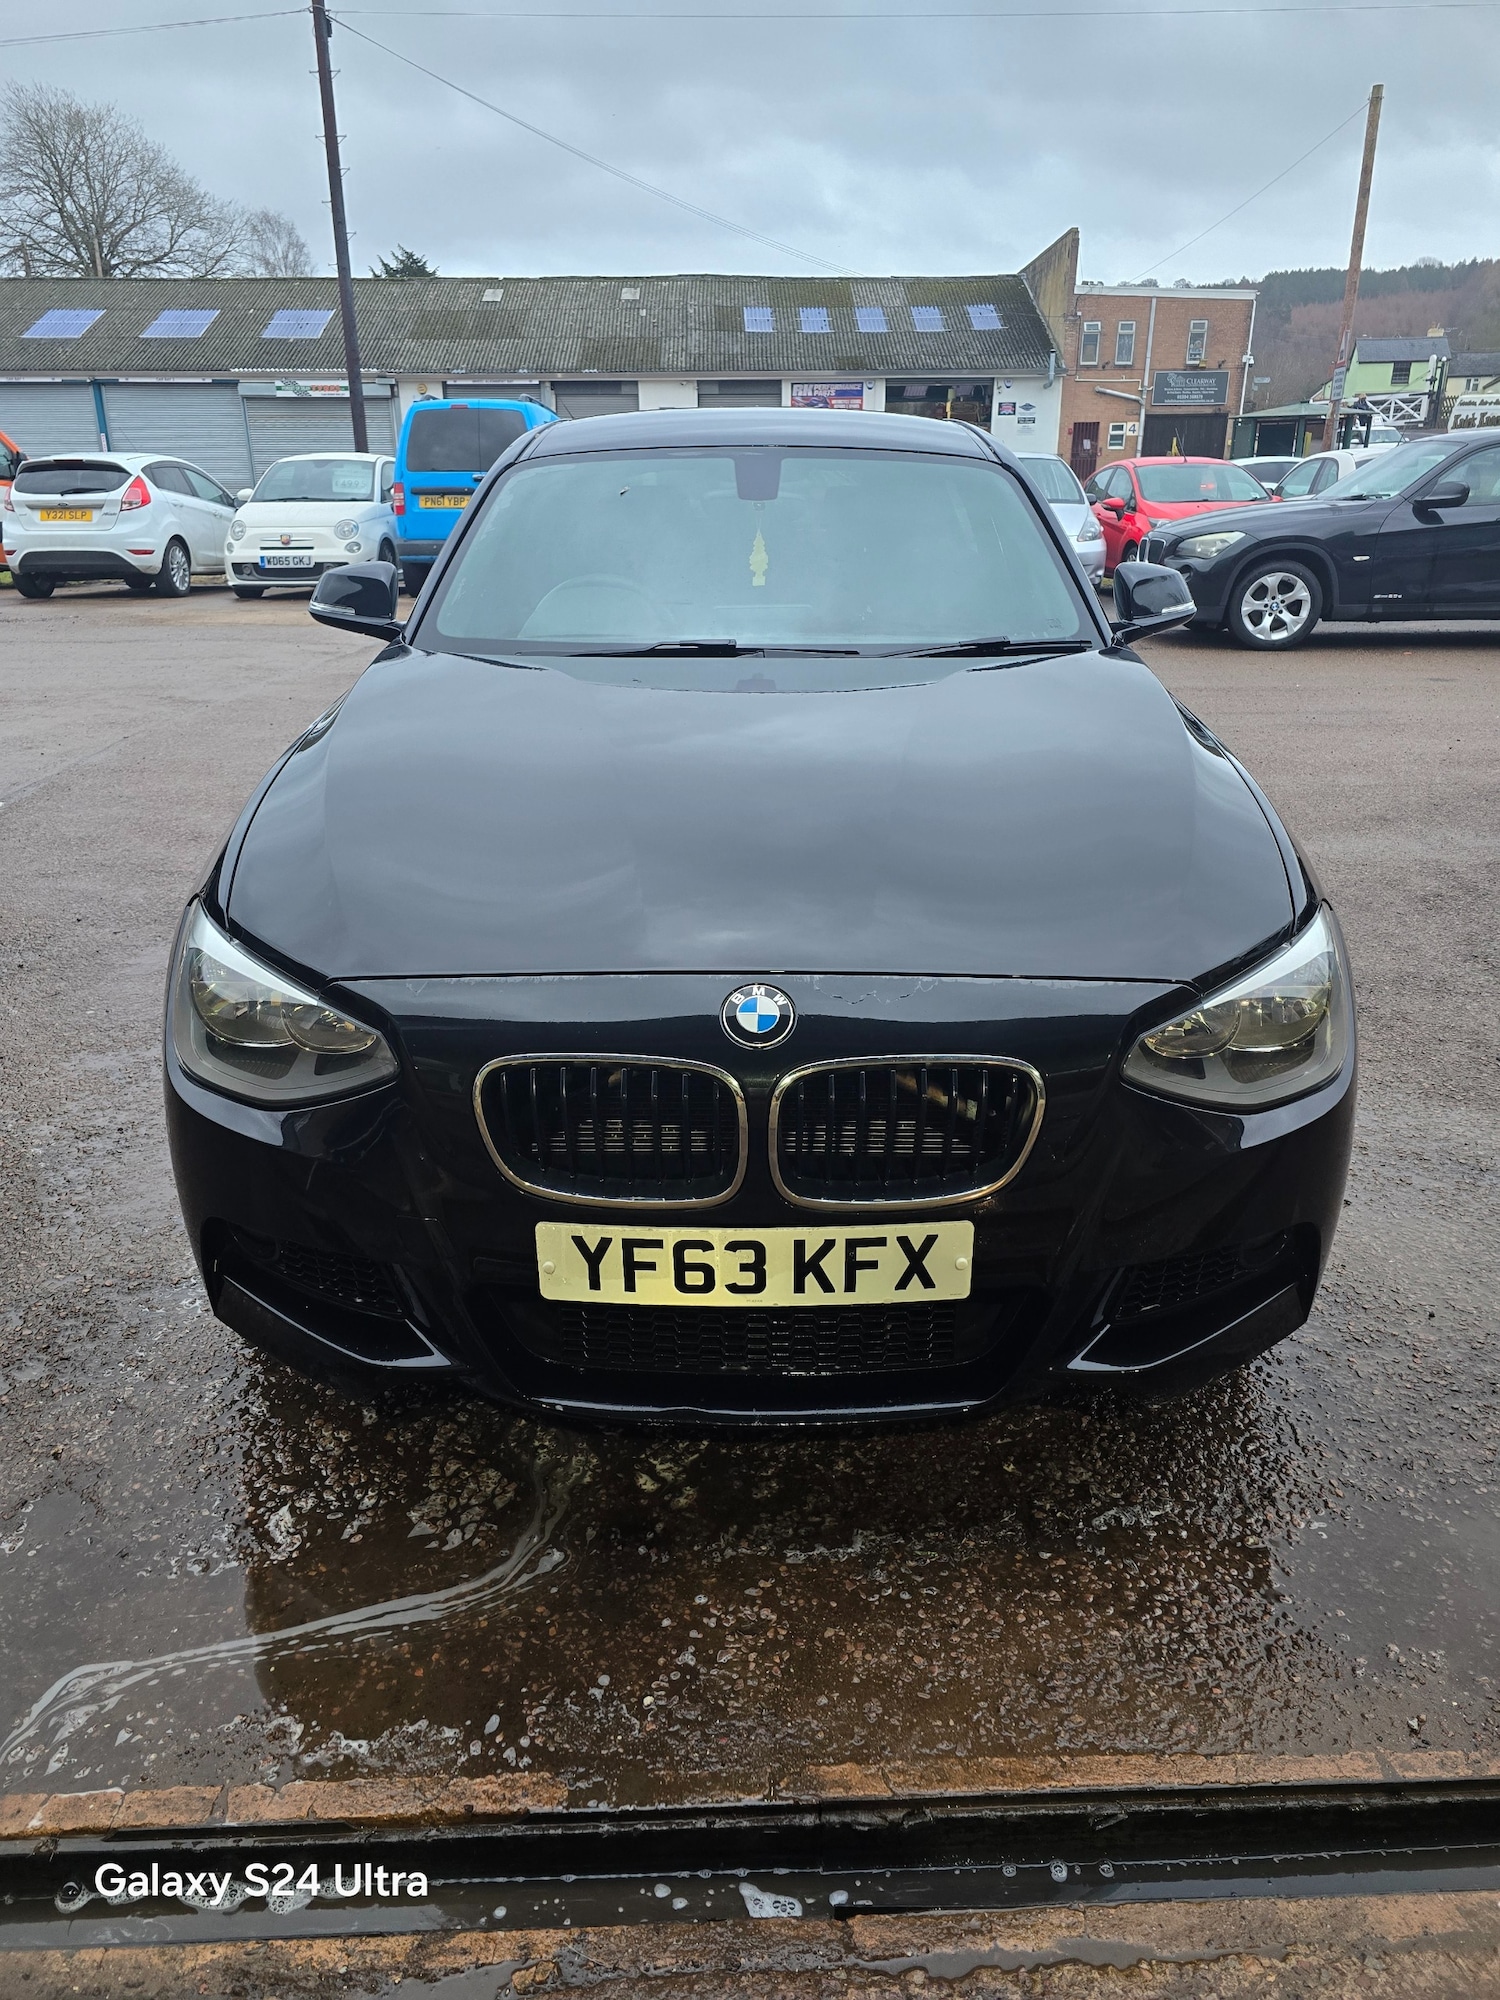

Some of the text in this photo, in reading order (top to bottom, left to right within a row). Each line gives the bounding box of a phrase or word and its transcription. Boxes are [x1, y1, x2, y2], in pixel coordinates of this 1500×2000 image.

[1128, 424, 1136, 434] 4
[424, 496, 465, 506] PN61 YBP
[46, 510, 87, 520] Y321 SLP
[266, 556, 311, 566] WD65 GKJ
[731, 985, 788, 1006] BMW
[571, 1234, 939, 1294] YF63 KFX
